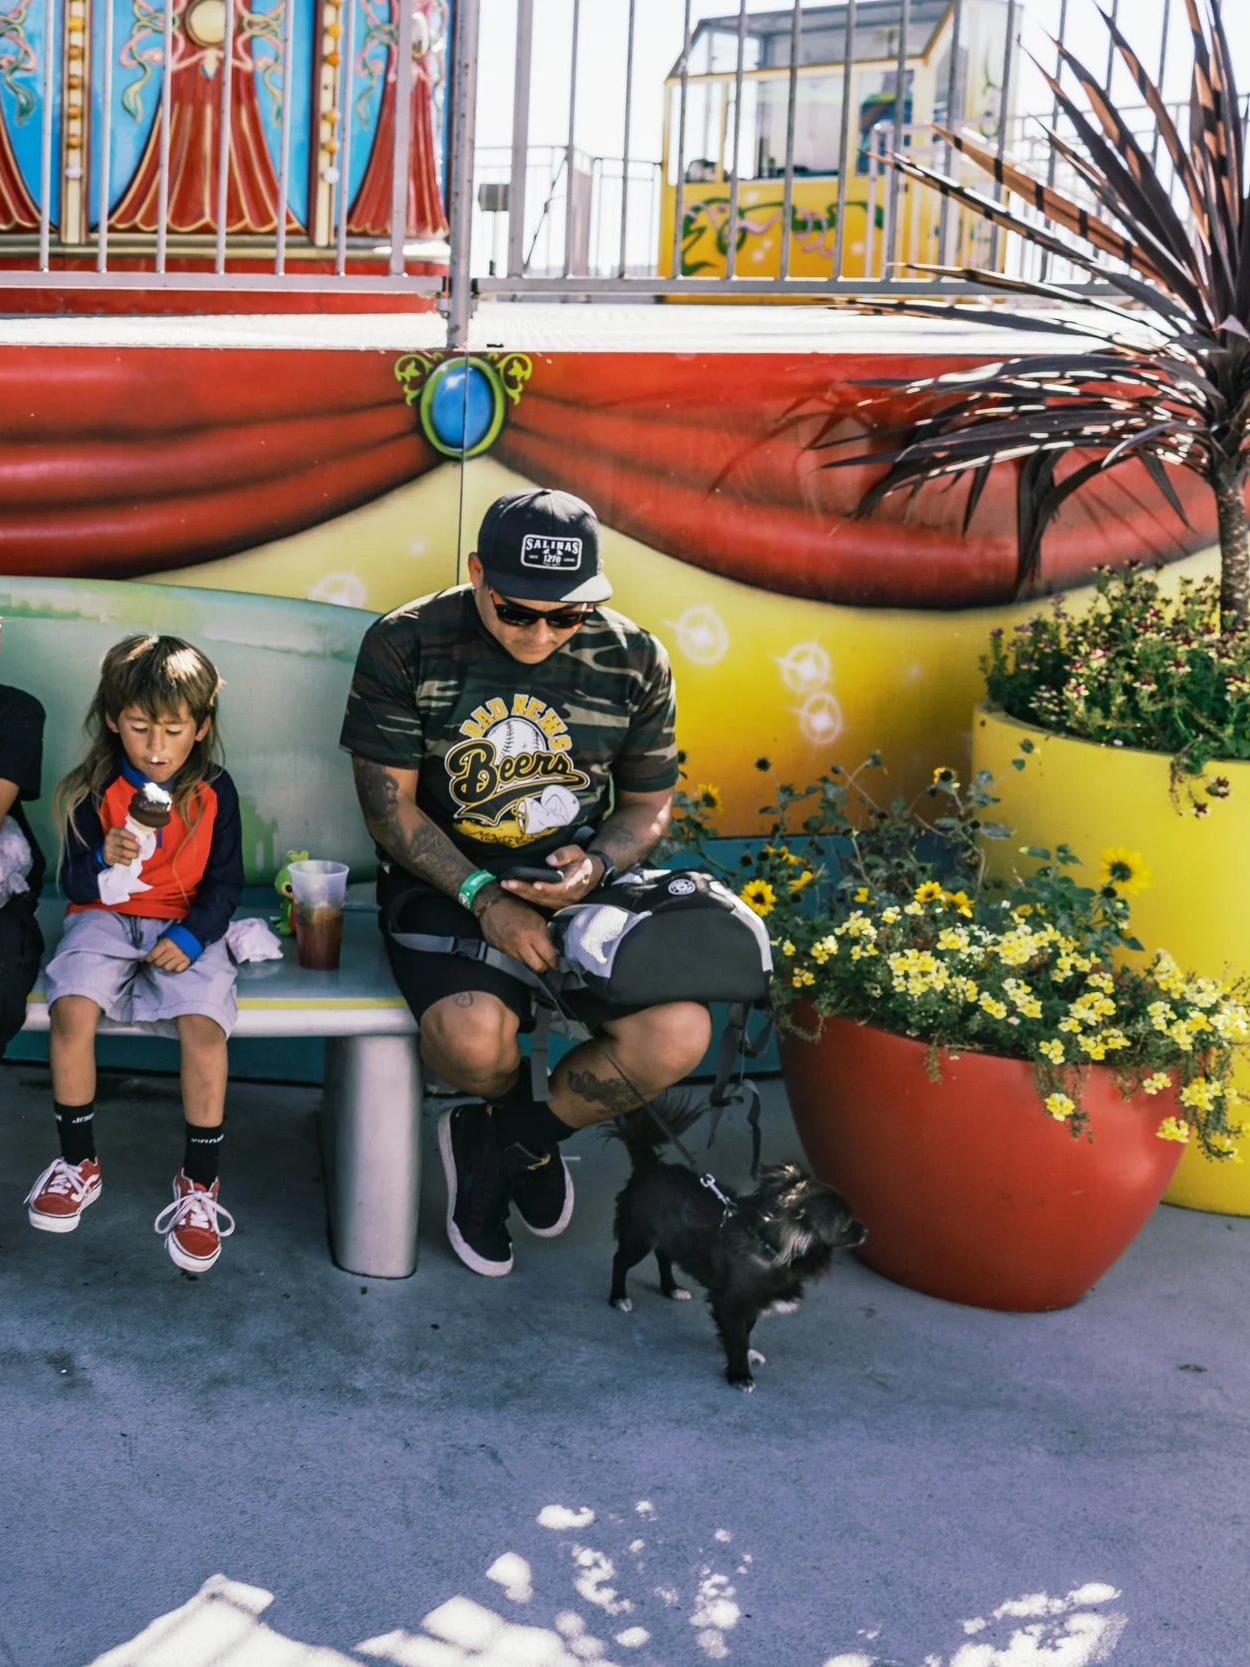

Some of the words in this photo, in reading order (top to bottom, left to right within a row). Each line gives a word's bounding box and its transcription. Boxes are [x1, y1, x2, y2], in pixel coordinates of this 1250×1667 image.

[525, 538, 579, 555] SALINAS
[459, 697, 509, 739] BAD
[510, 693, 573, 751] NEWS
[446, 739, 576, 806] Beers
